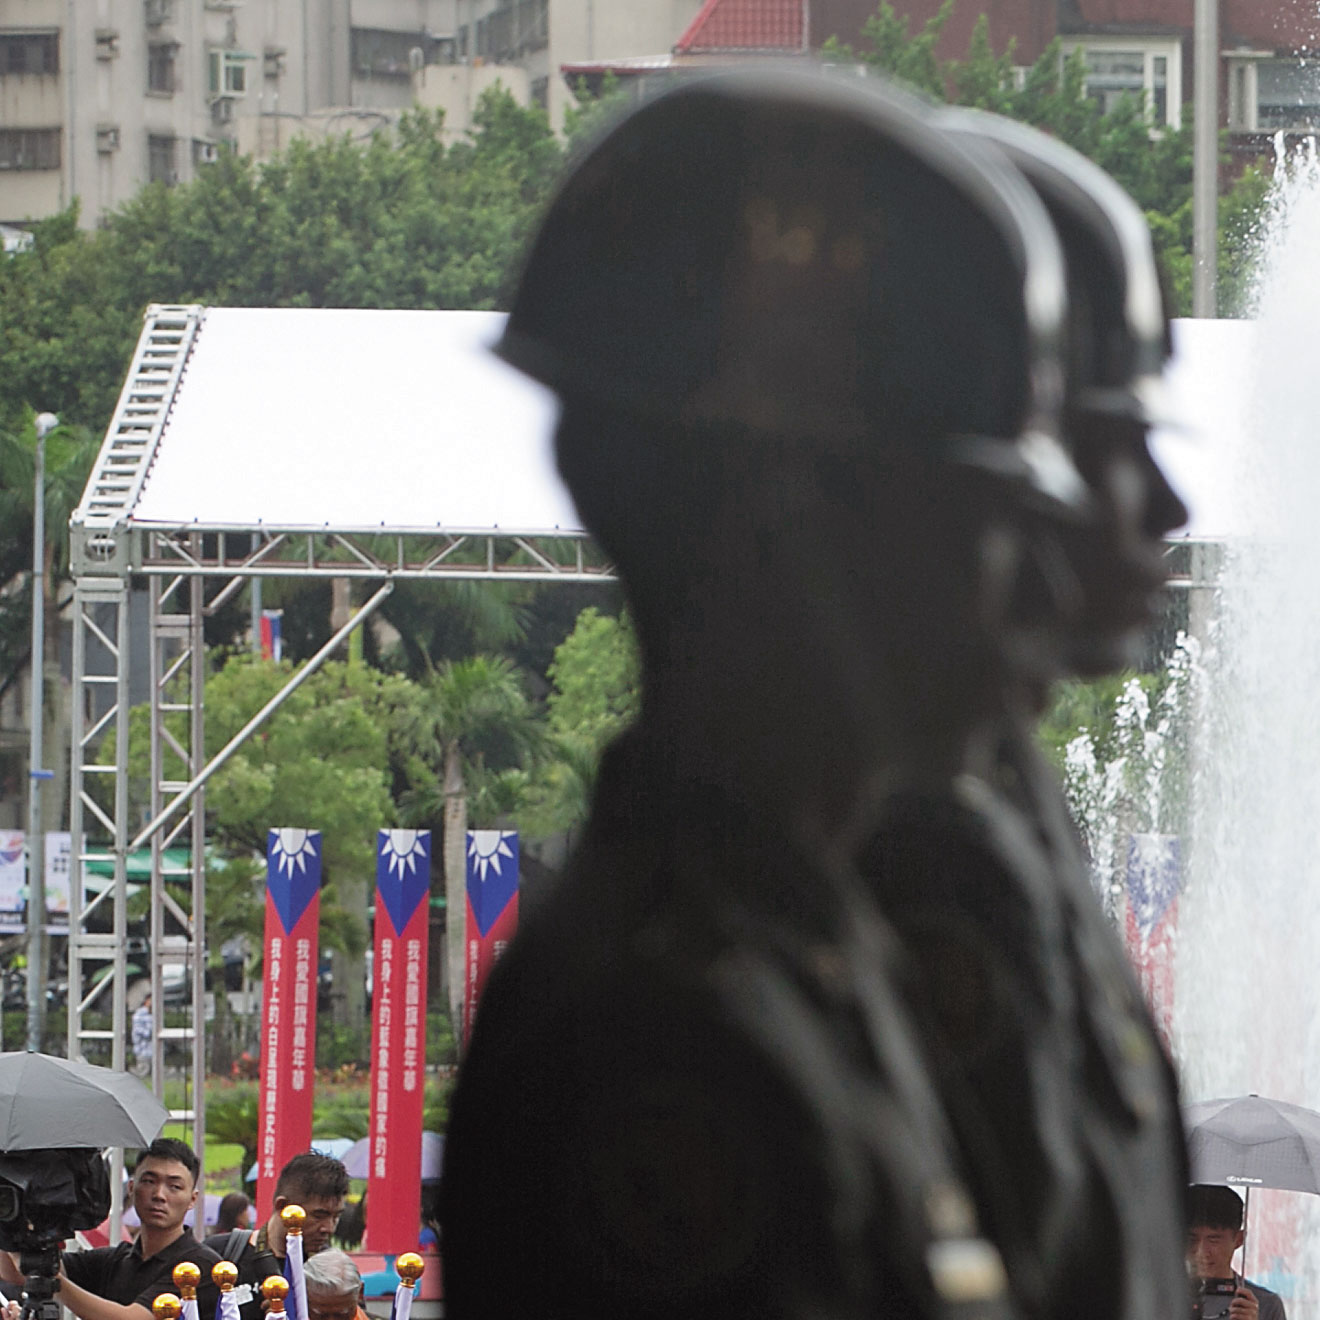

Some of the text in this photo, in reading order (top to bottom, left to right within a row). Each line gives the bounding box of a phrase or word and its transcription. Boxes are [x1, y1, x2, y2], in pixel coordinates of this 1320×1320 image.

[292, 938, 311, 1092] 我愛國旗嘉年華
[403, 938, 420, 1093] 我愛國旗嘉年華
